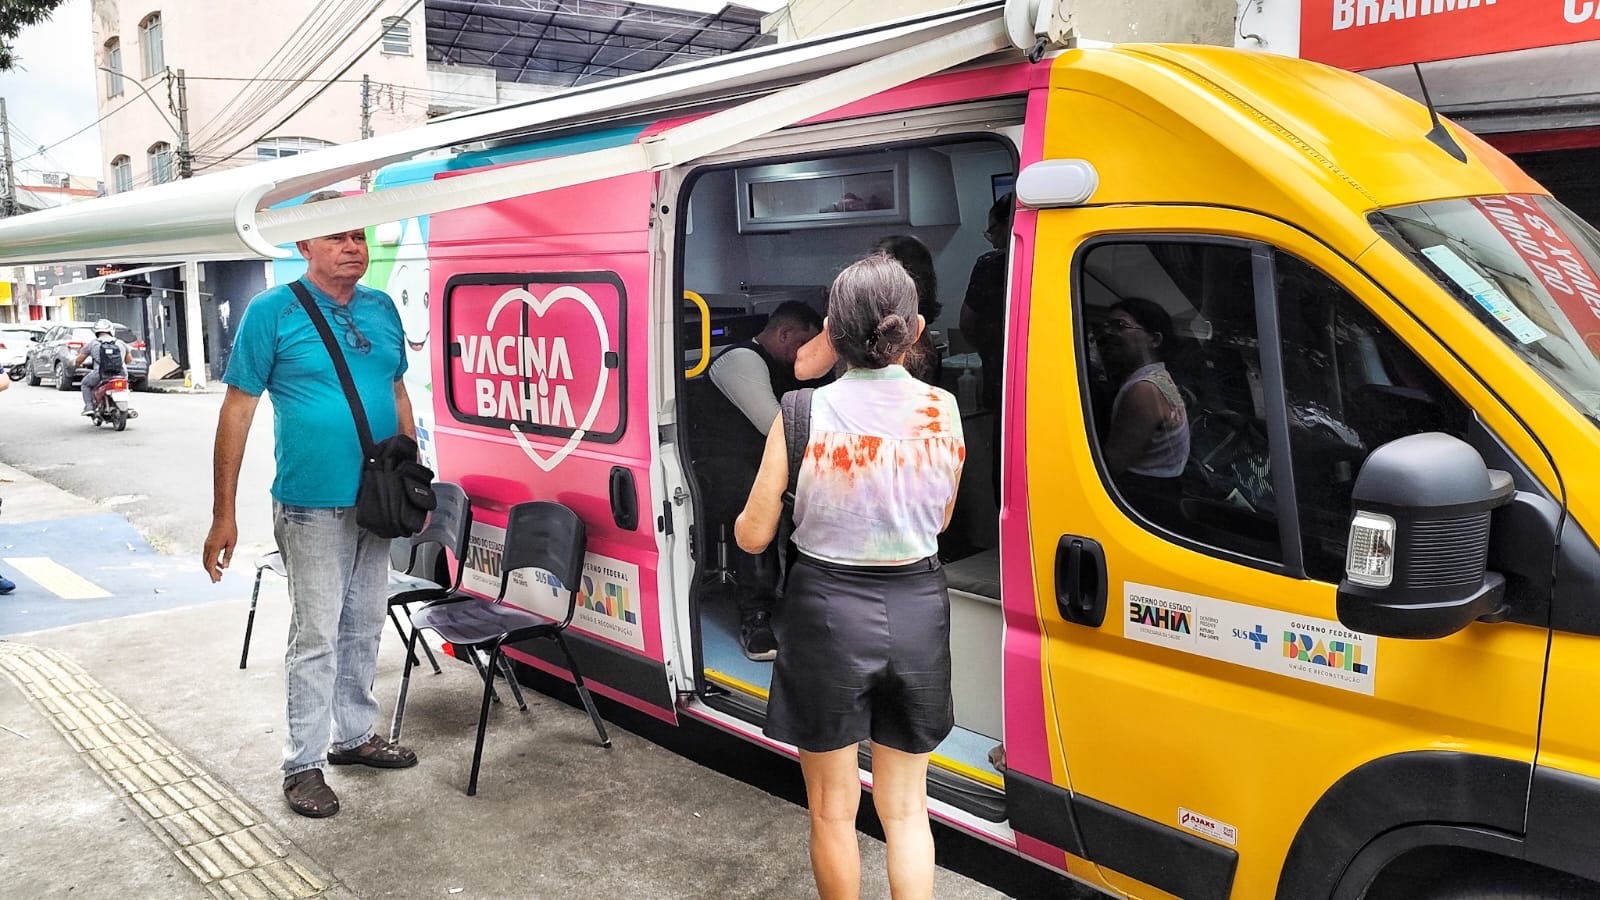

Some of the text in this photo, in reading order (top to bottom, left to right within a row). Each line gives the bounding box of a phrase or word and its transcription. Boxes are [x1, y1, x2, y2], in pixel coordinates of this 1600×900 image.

[1333, 0, 1496, 30] BRA
[457, 334, 574, 380] VACINA
[475, 372, 577, 428] BAHIA
[535, 570, 547, 584] SUS
[603, 567, 629, 581] FEDERAL
[1129, 594, 1192, 613] GOVERNO DO ESTADO
[1129, 602, 1191, 635] BAHIA
[1232, 628, 1248, 640] SUS
[1290, 621, 1363, 641] GOVERNO FEDERAL
[1283, 631, 1368, 675] BRASIL
[1288, 663, 1307, 672] UNIÃO
